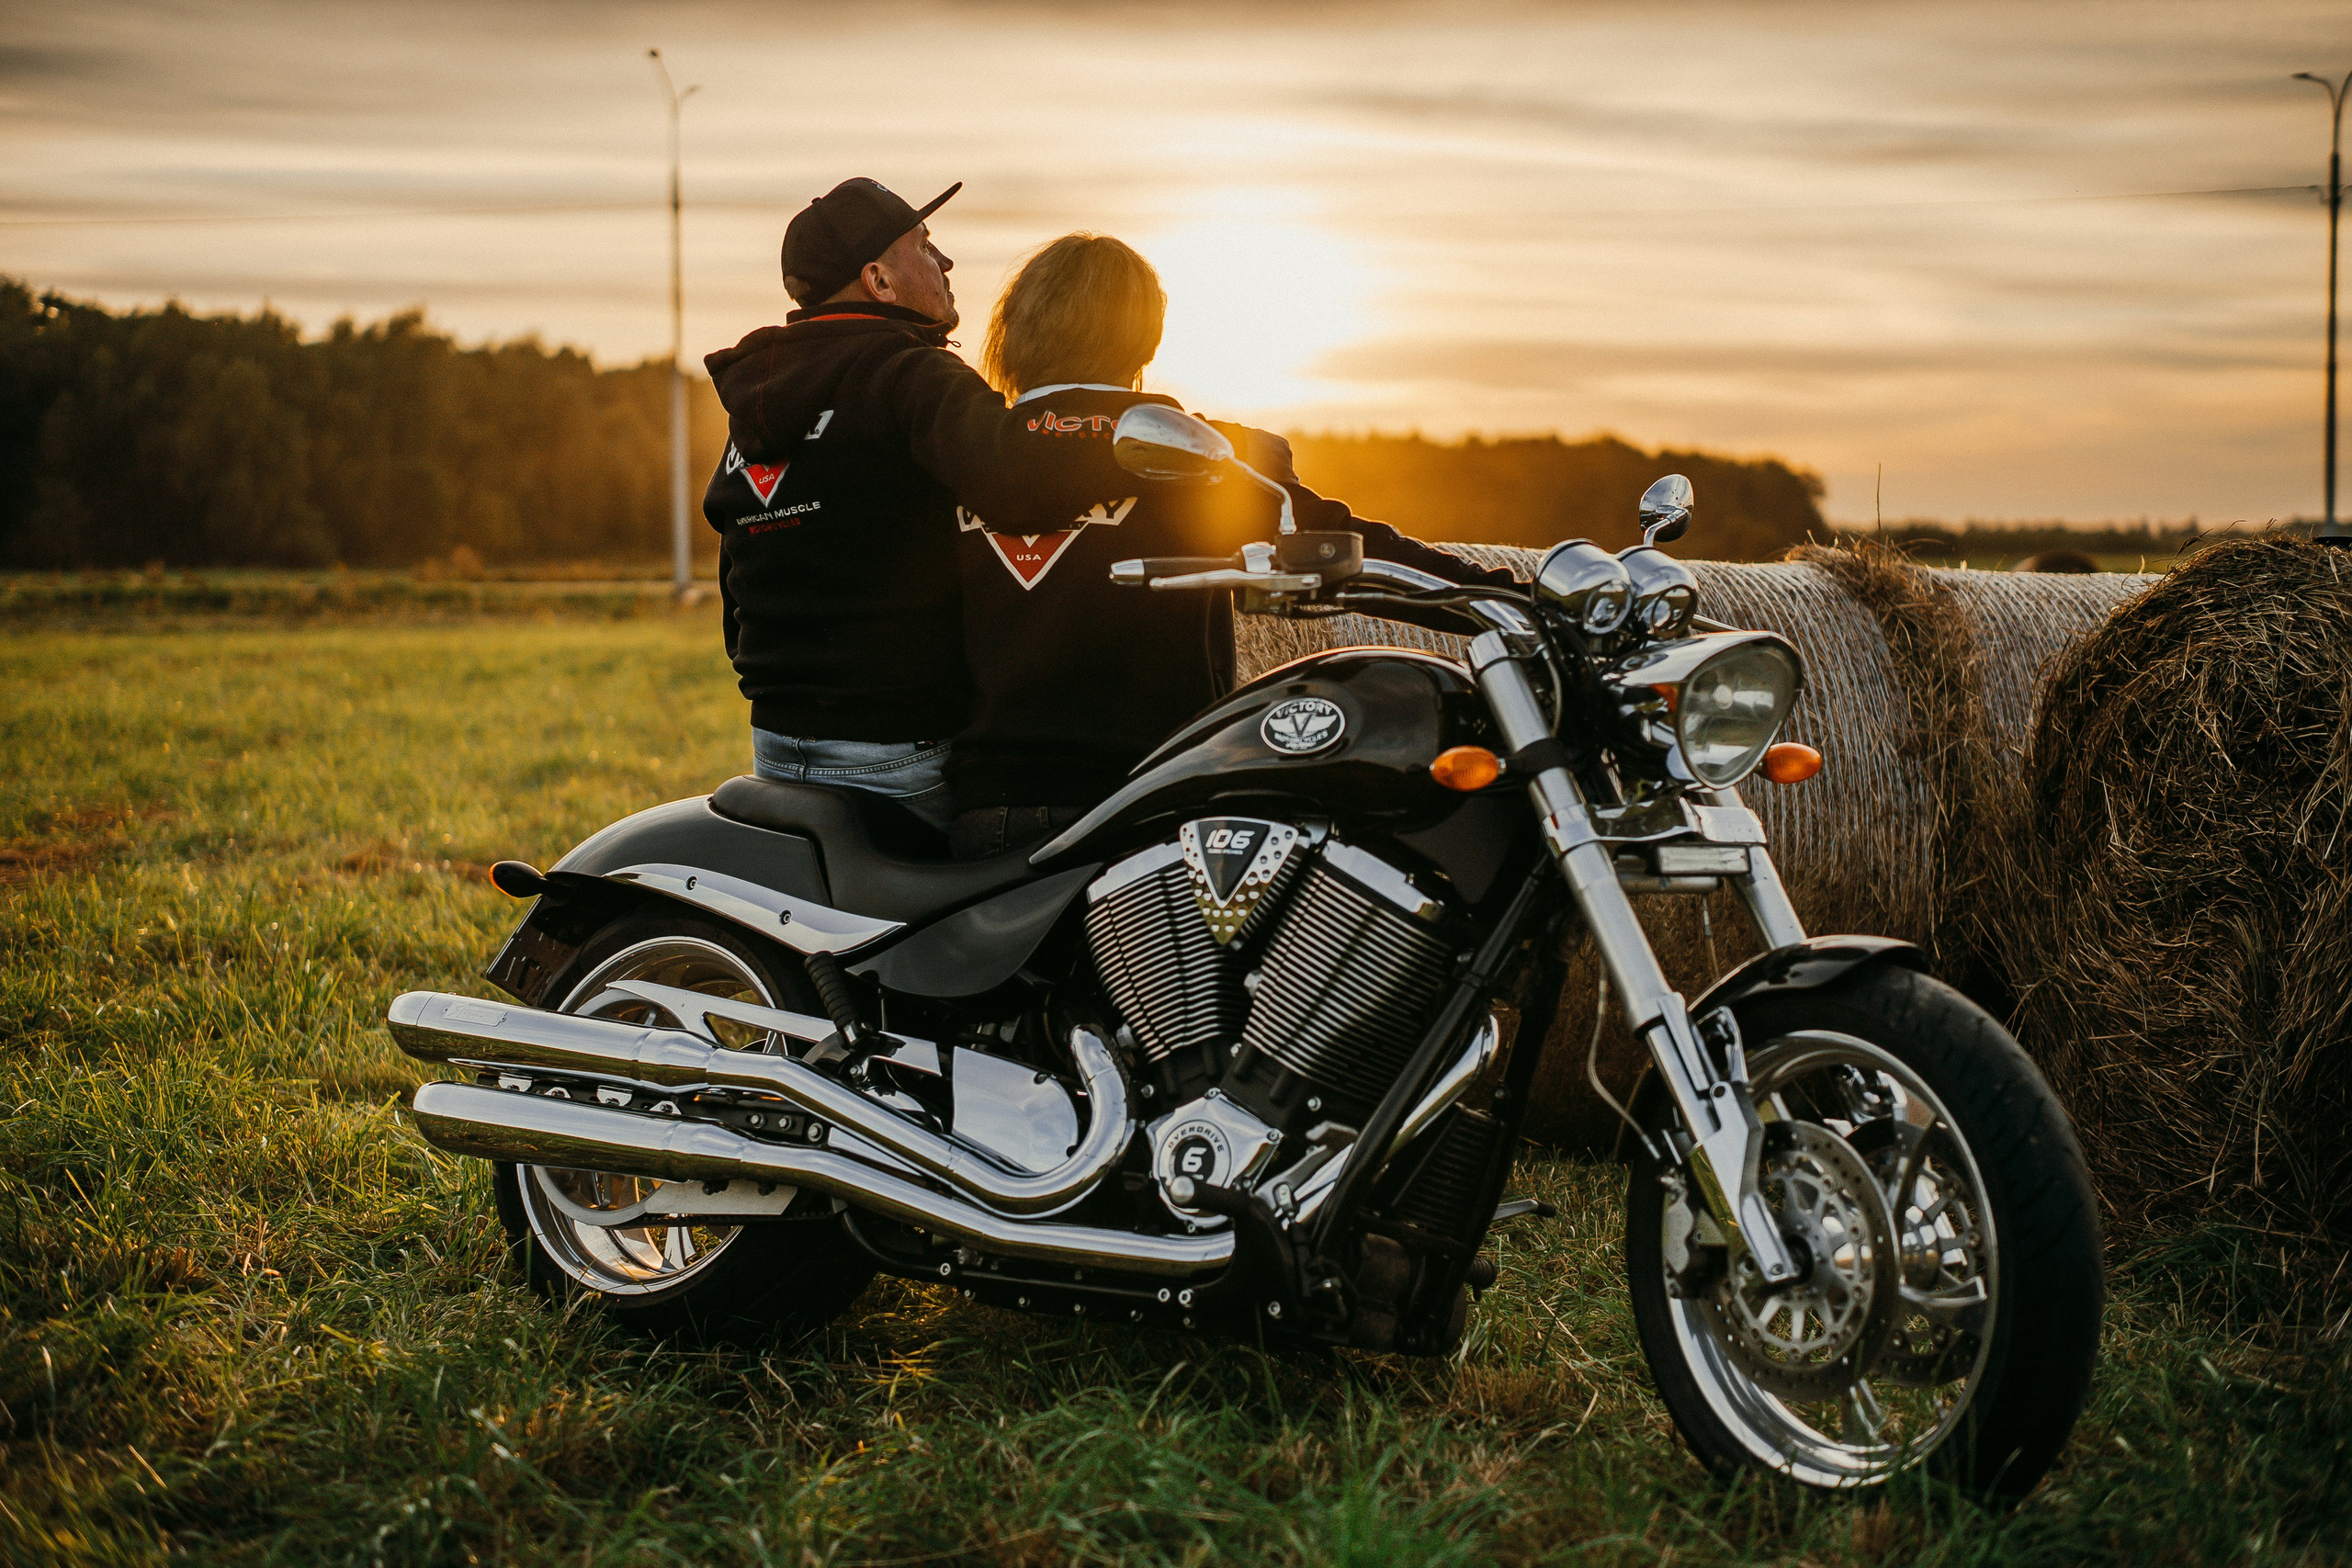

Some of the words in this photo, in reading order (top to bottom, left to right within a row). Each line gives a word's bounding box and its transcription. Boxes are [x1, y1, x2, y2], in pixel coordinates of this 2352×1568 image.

[758, 473, 775, 485] USA
[774, 502, 821, 519] MUSCLE
[1016, 553, 1042, 562] USA
[1276, 702, 1332, 718] VICTORY
[1204, 829, 1256, 849] 106
[1168, 1125, 1225, 1153] OVERDRIVE
[1182, 1146, 1207, 1173] 6
